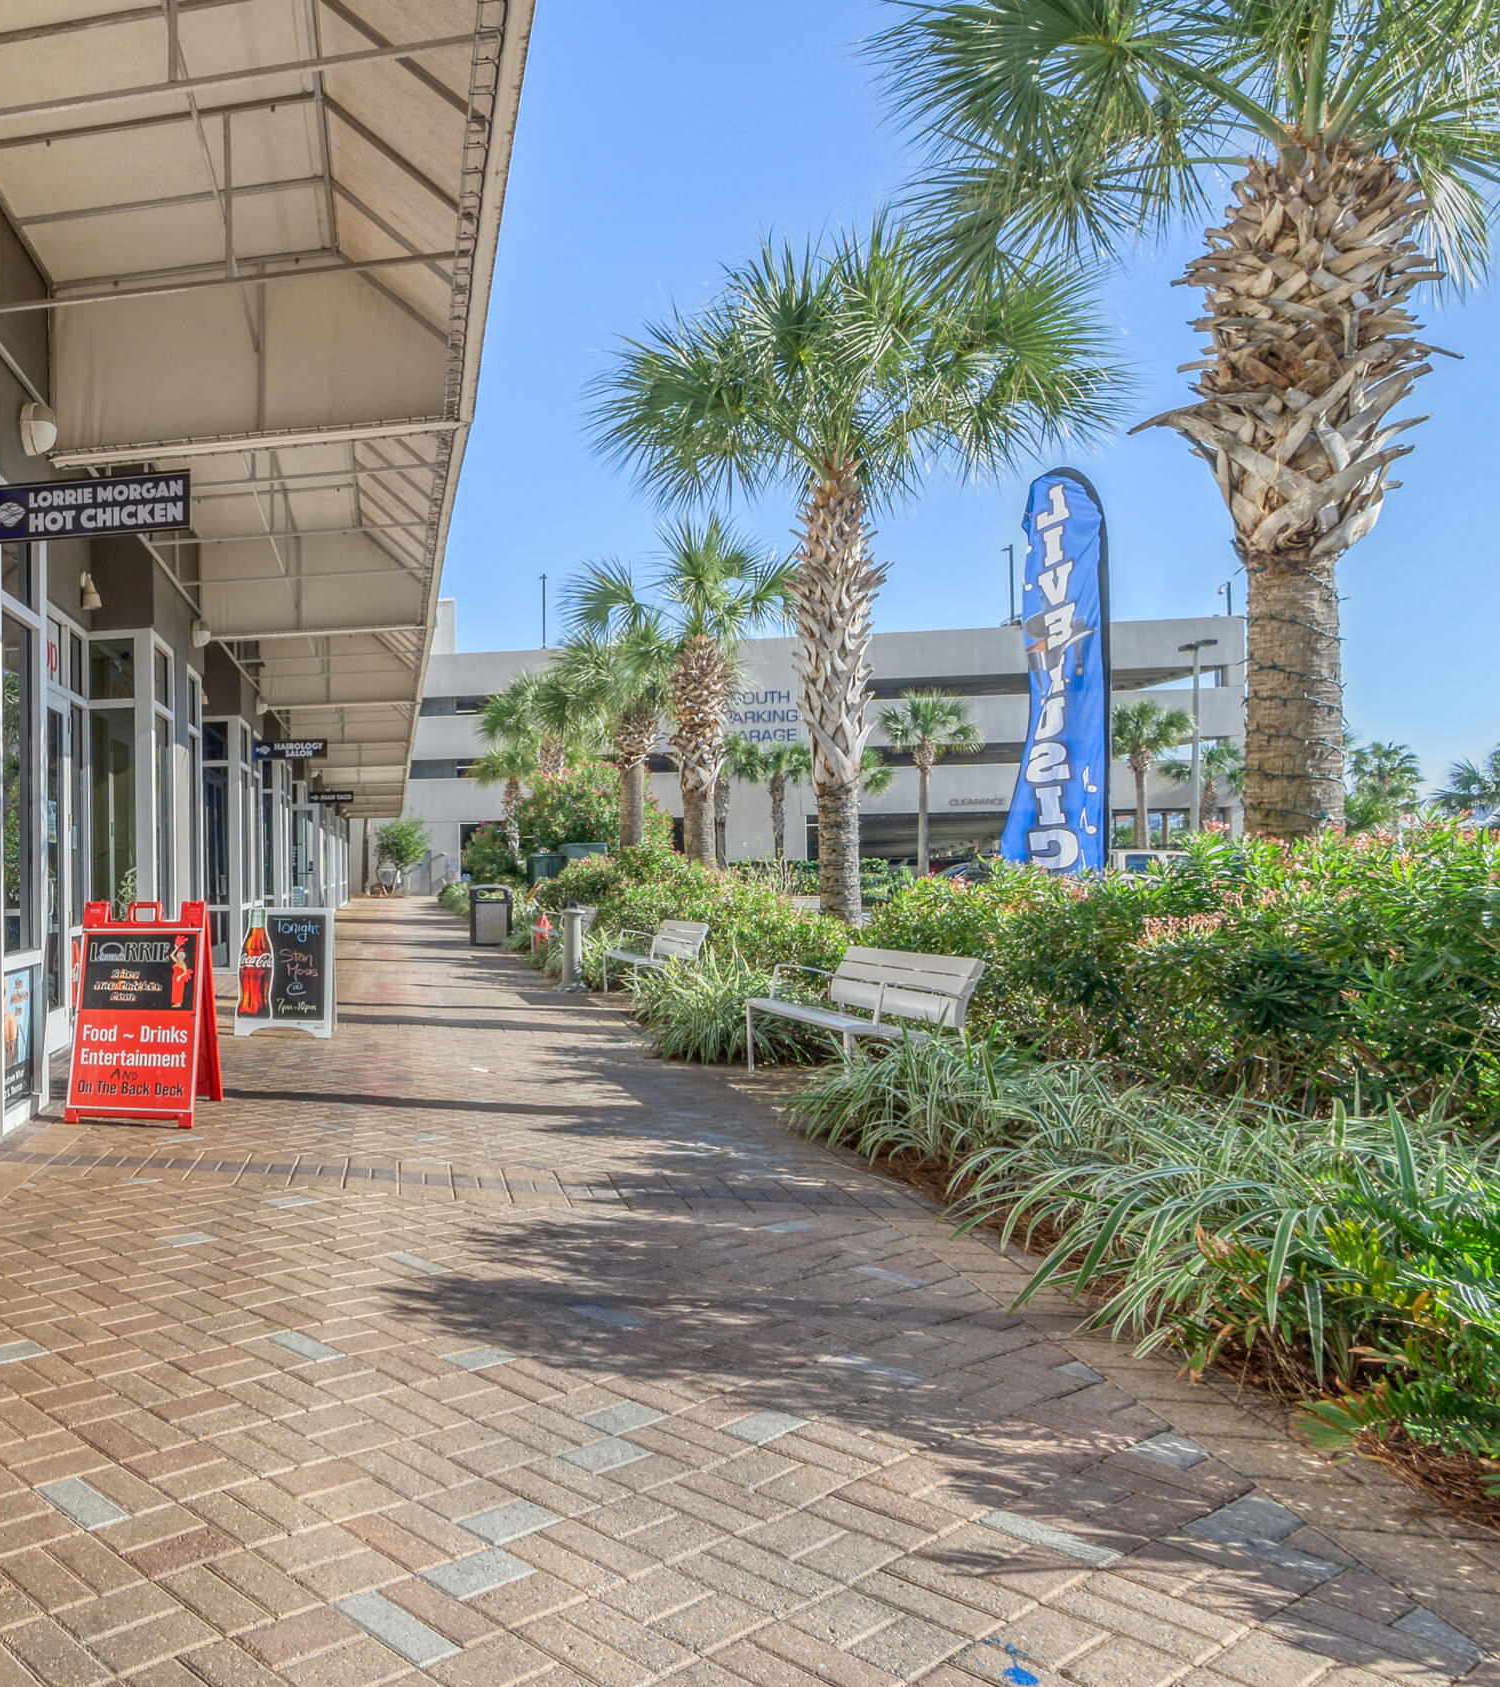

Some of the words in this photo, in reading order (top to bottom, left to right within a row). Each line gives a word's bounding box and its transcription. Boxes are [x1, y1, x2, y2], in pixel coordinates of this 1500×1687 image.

[29, 487, 93, 508] LORRIE
[97, 480, 183, 503] MORGAN
[29, 510, 76, 533] HOT
[80, 501, 184, 529] CHICKEN
[726, 728, 797, 742] ARAGE
[274, 742, 324, 750] HAIROLOGY
[948, 797, 1005, 806] CLEARANCE
[272, 917, 321, 943] Tonight
[89, 942, 171, 962] LORRIE
[279, 948, 313, 967] Stan
[286, 963, 319, 981] Moss
[286, 981, 307, 996] @
[82, 1024, 118, 1042] Food
[140, 1025, 188, 1044] Drinks
[80, 1048, 187, 1068] Entertainment
[110, 1067, 138, 1081] AND
[78, 1080, 93, 1094] On
[97, 1080, 117, 1095] The
[121, 1081, 151, 1096] Back
[154, 1082, 184, 1097] Deck
